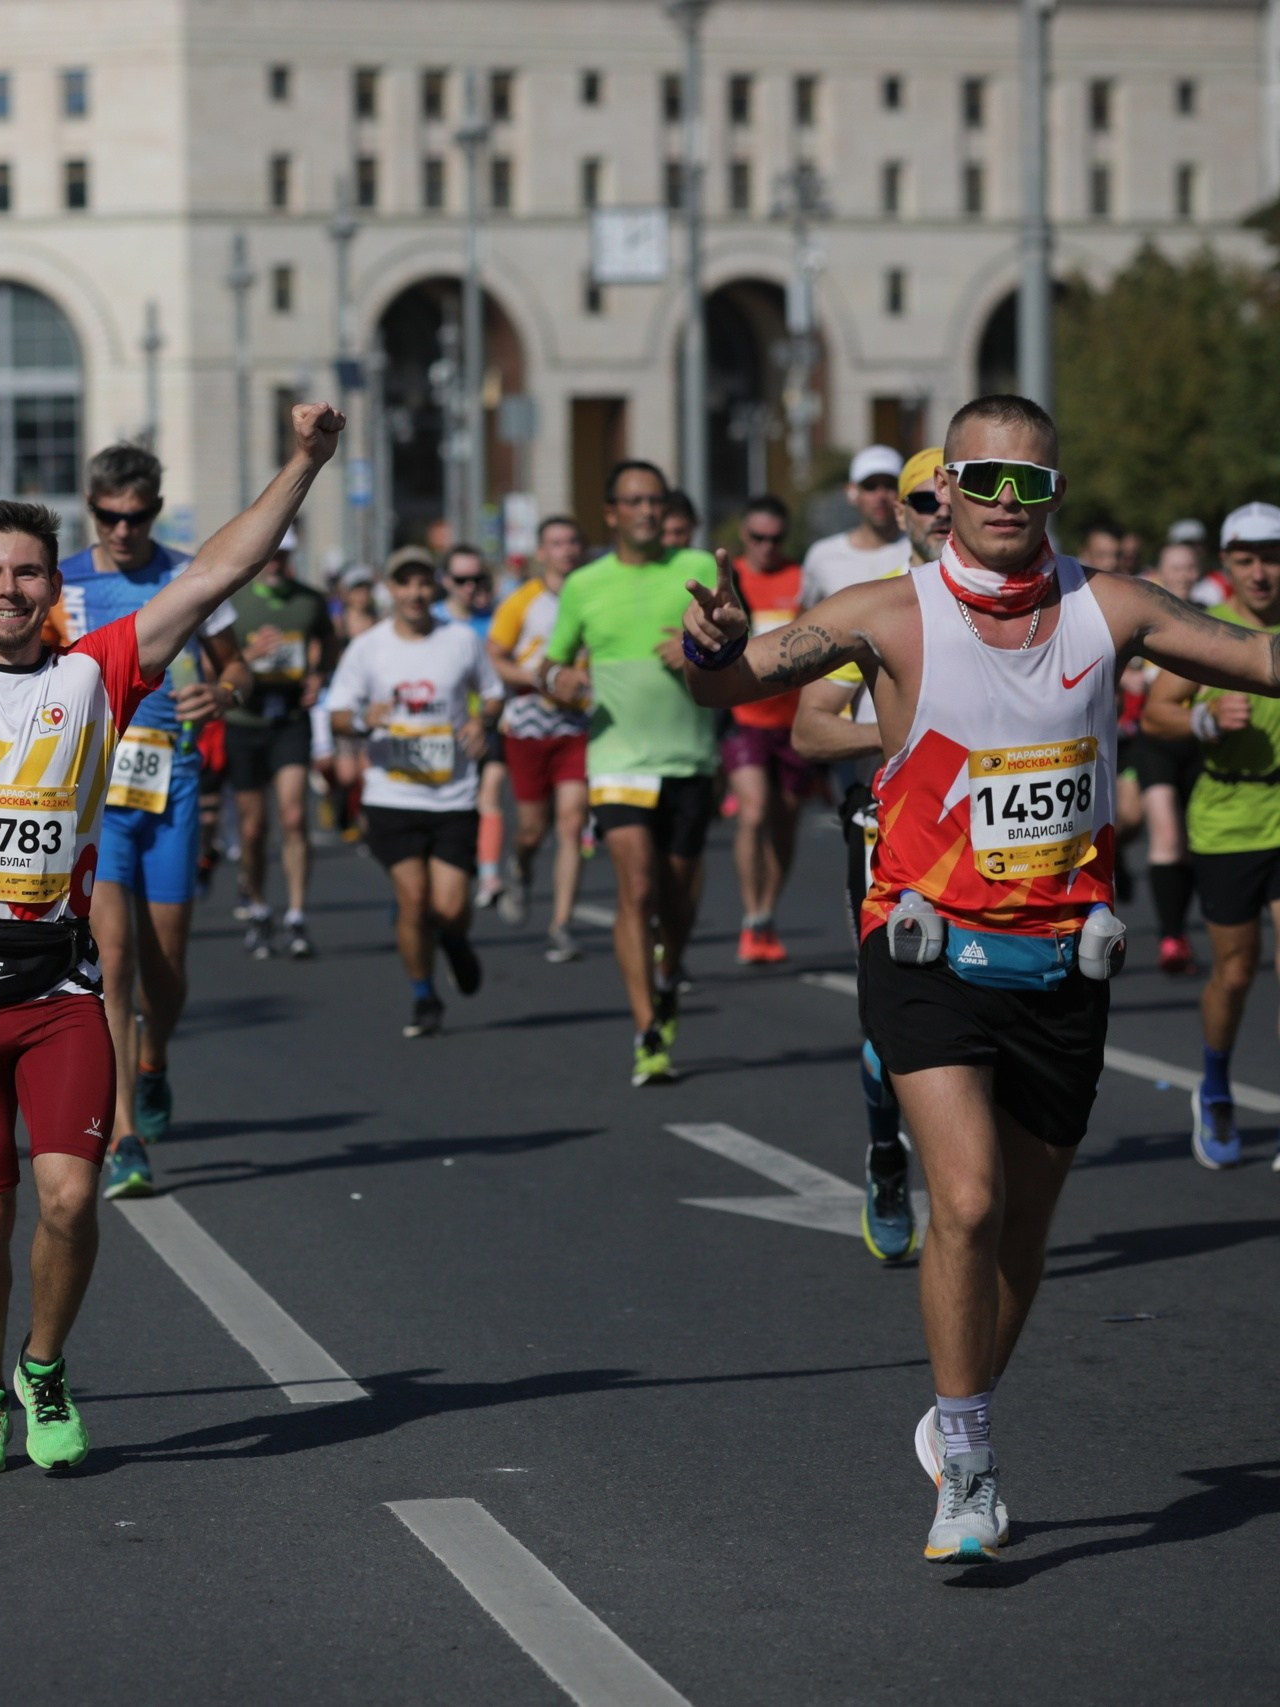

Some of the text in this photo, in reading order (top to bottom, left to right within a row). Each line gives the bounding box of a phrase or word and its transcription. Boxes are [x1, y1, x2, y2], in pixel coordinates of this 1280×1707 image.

[1007, 747, 1060, 760] МАРАФОН
[1008, 758, 1053, 770] МОСКВА
[977, 773, 1092, 826] 14598
[1008, 821, 1074, 840] ВЛАДИСЛАВ
[0, 857, 32, 868] БУЛАТ
[986, 851, 1006, 875] G
